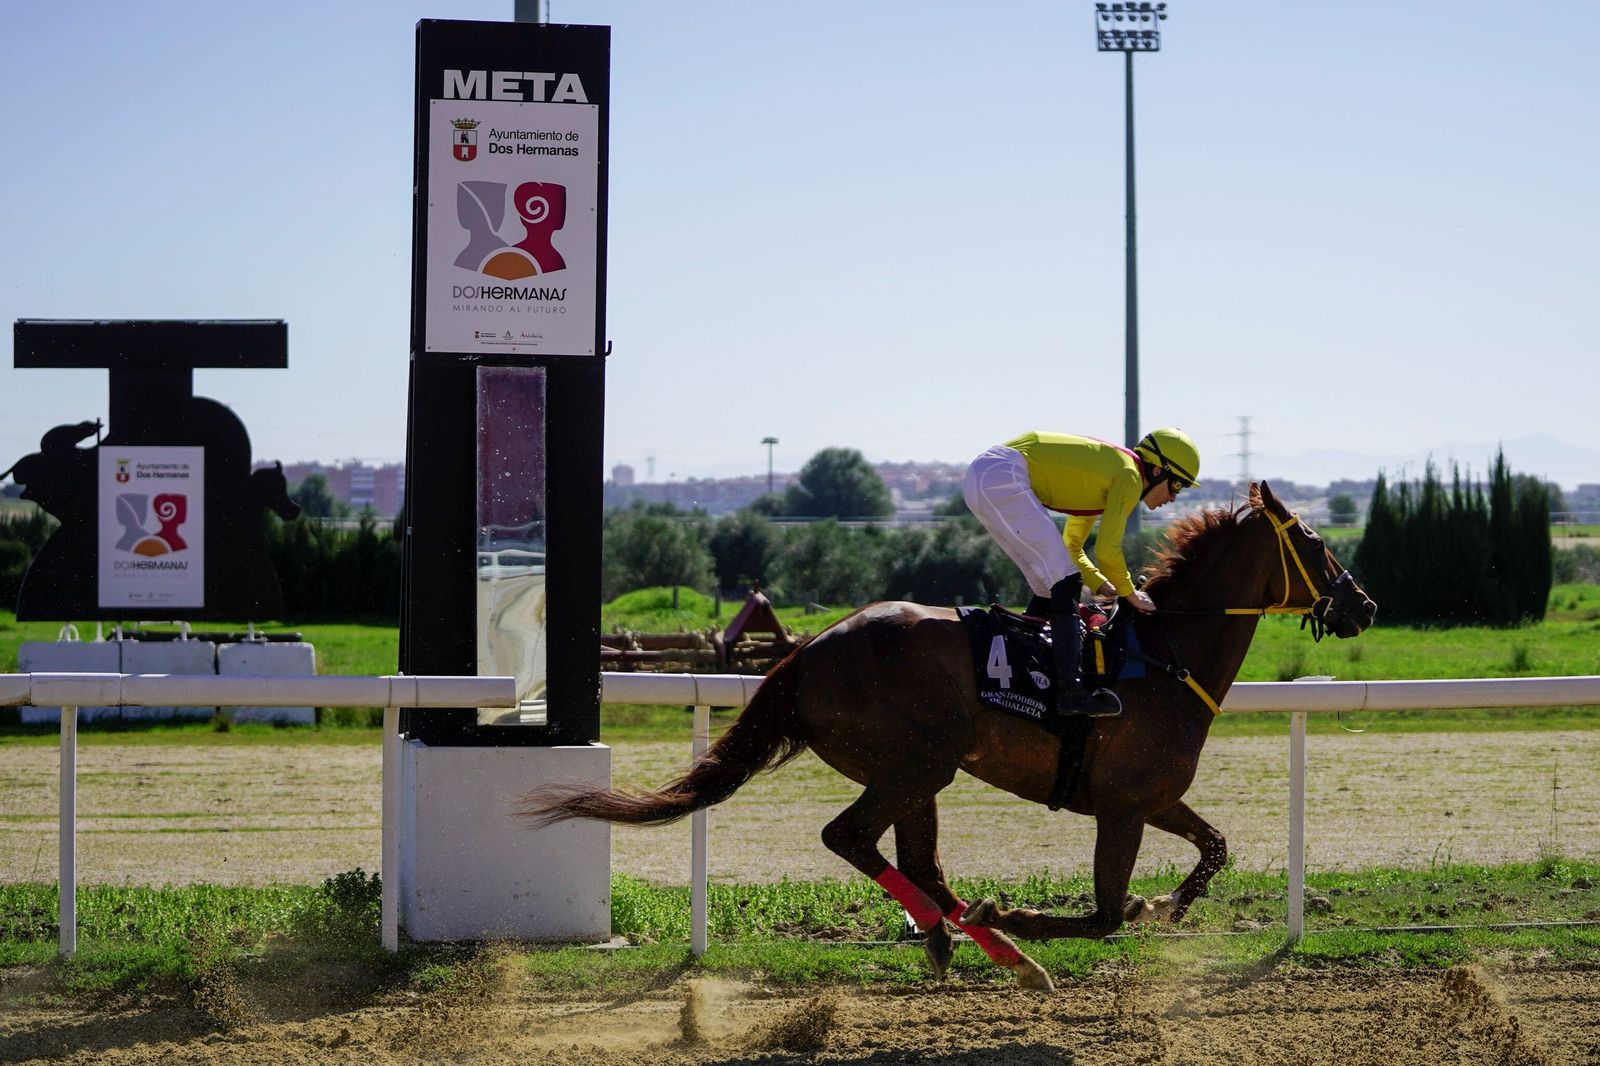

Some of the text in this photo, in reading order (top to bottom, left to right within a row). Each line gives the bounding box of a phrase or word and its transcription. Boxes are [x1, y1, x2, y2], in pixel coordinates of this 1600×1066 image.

[443, 69, 589, 103] META
[488, 128, 579, 141] Ayuntamiento de
[489, 143, 579, 156] Dos Hermanas
[452, 304, 567, 314] MIRANDO AL FUTURO
[136, 470, 190, 479] Dos Hermanas
[986, 634, 1013, 689] 4
